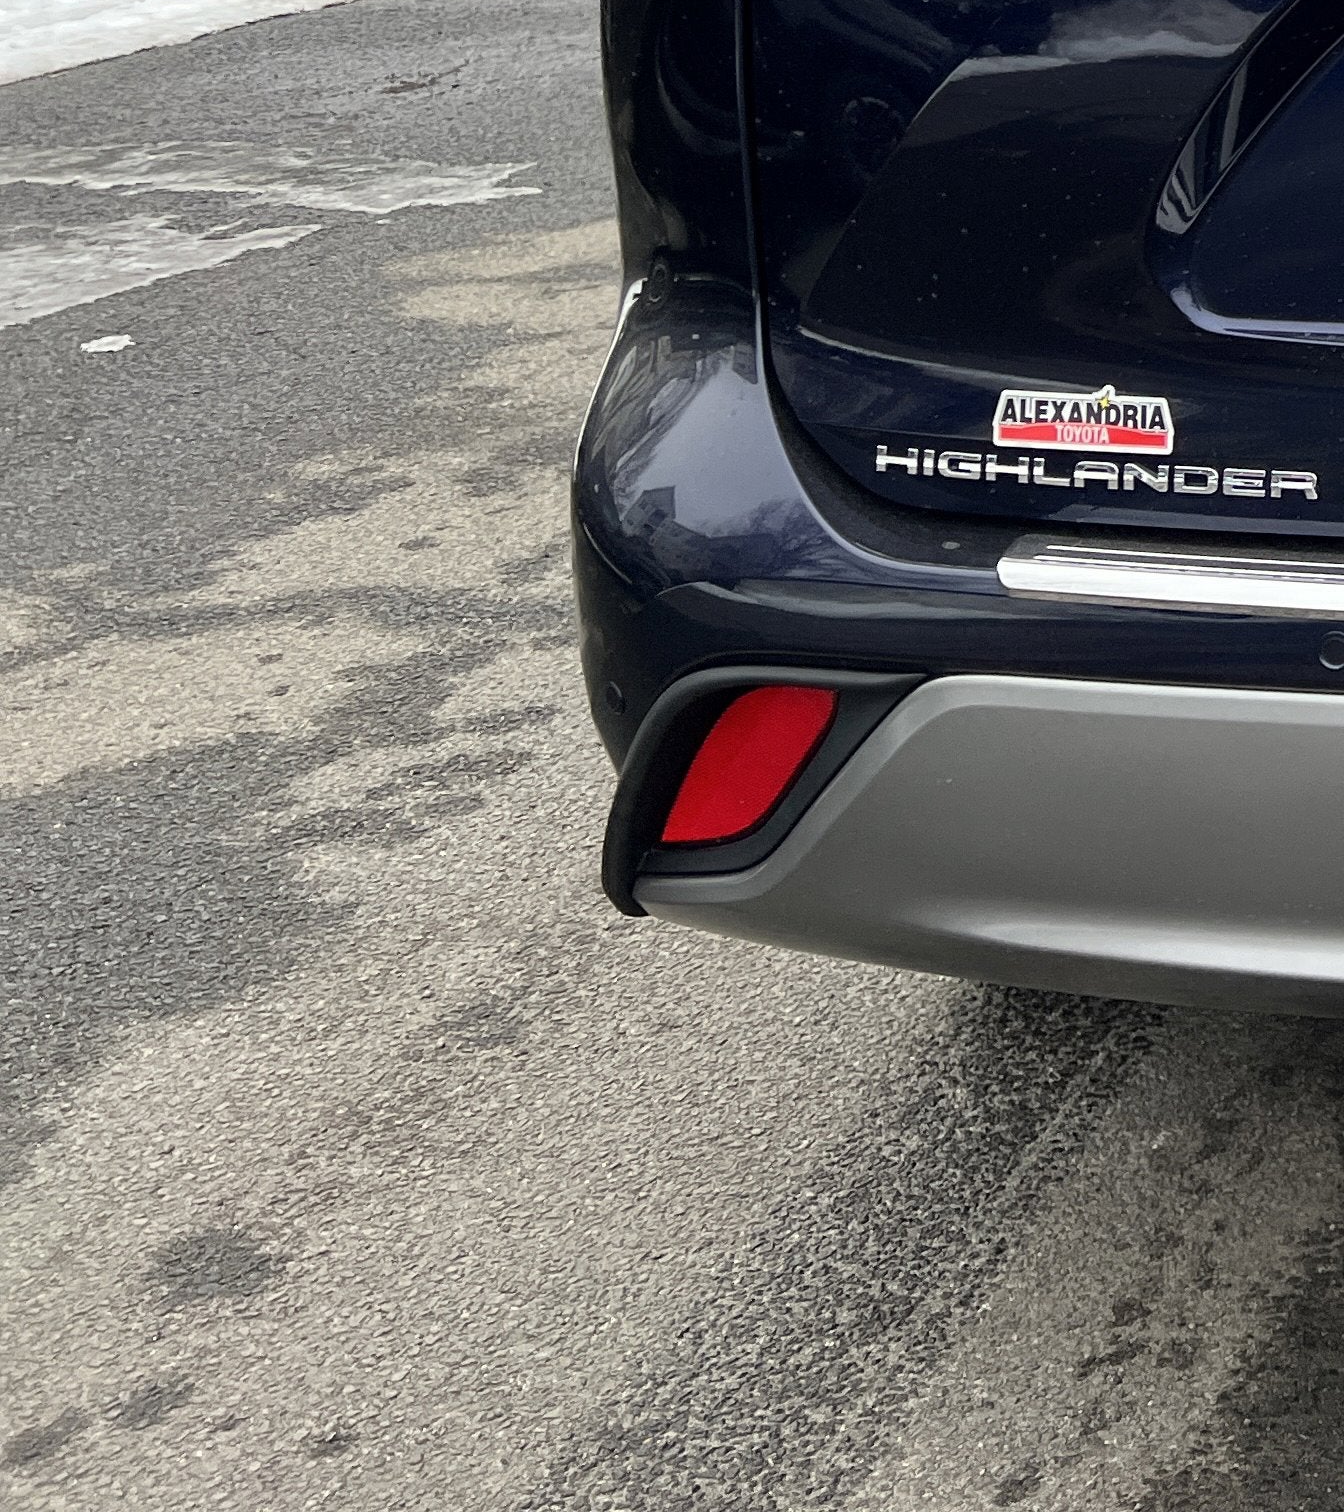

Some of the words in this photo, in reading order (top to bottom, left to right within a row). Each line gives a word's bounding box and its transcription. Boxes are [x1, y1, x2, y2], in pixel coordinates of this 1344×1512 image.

[1000, 397, 1167, 431] ALEXANDRIA
[1055, 424, 1110, 445] TOYOTA
[875, 445, 1318, 500] HIGHLANDER
